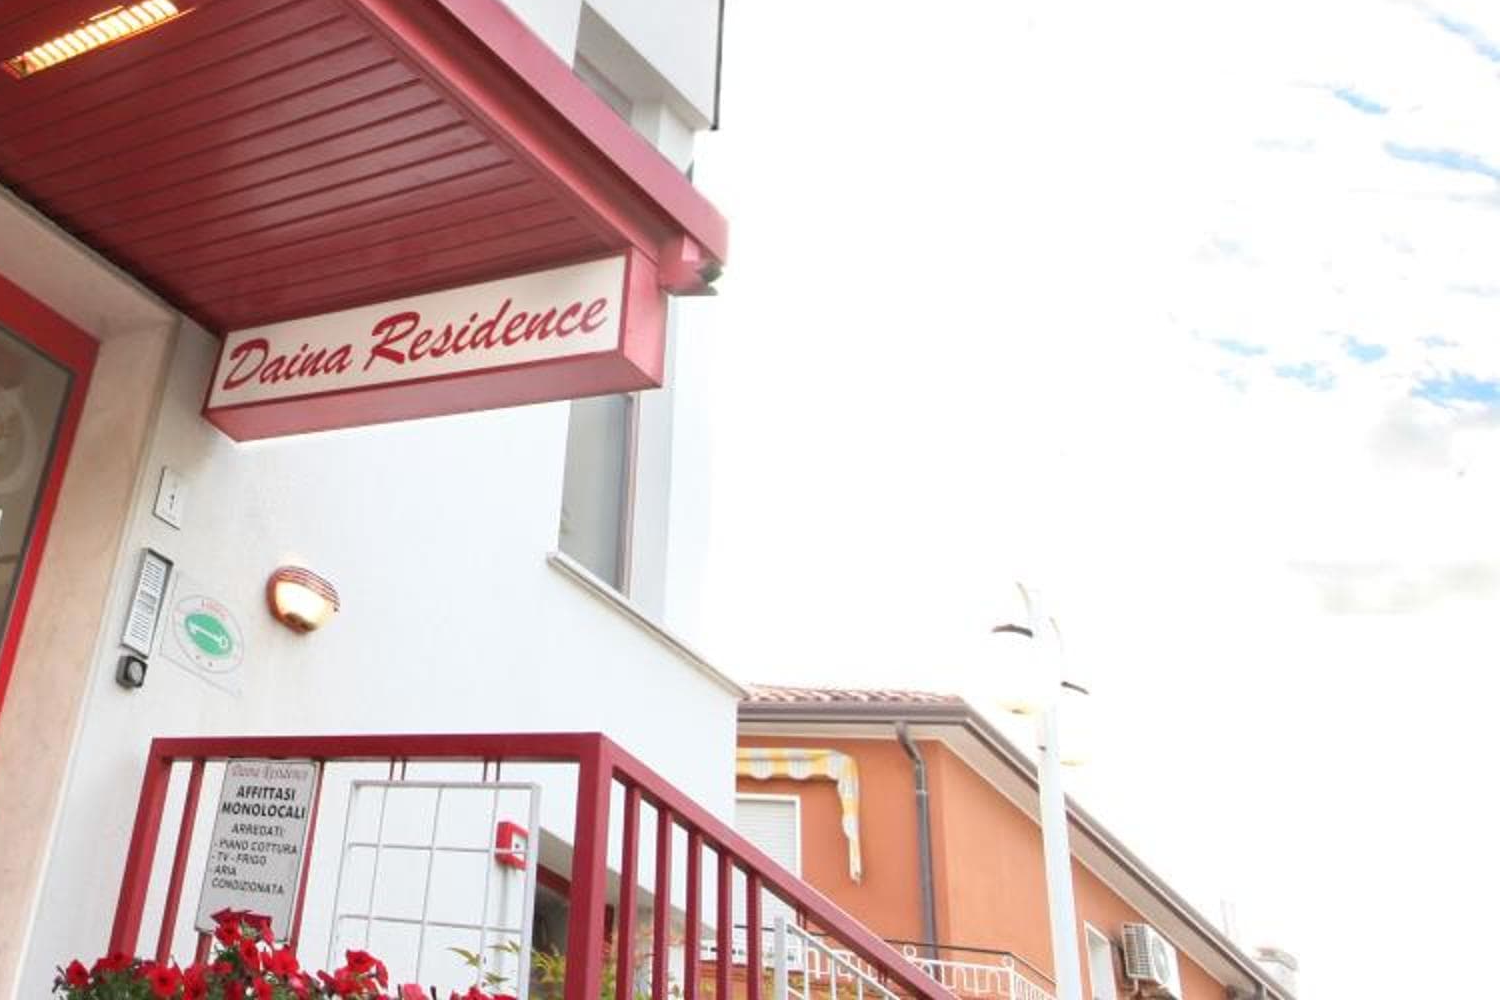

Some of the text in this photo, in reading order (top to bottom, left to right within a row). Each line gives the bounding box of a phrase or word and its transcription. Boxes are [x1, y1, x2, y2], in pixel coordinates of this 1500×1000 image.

[222, 296, 608, 391] Daina Residence
[236, 785, 296, 800] AFFITTASI
[221, 802, 305, 819] MONOLOCALI
